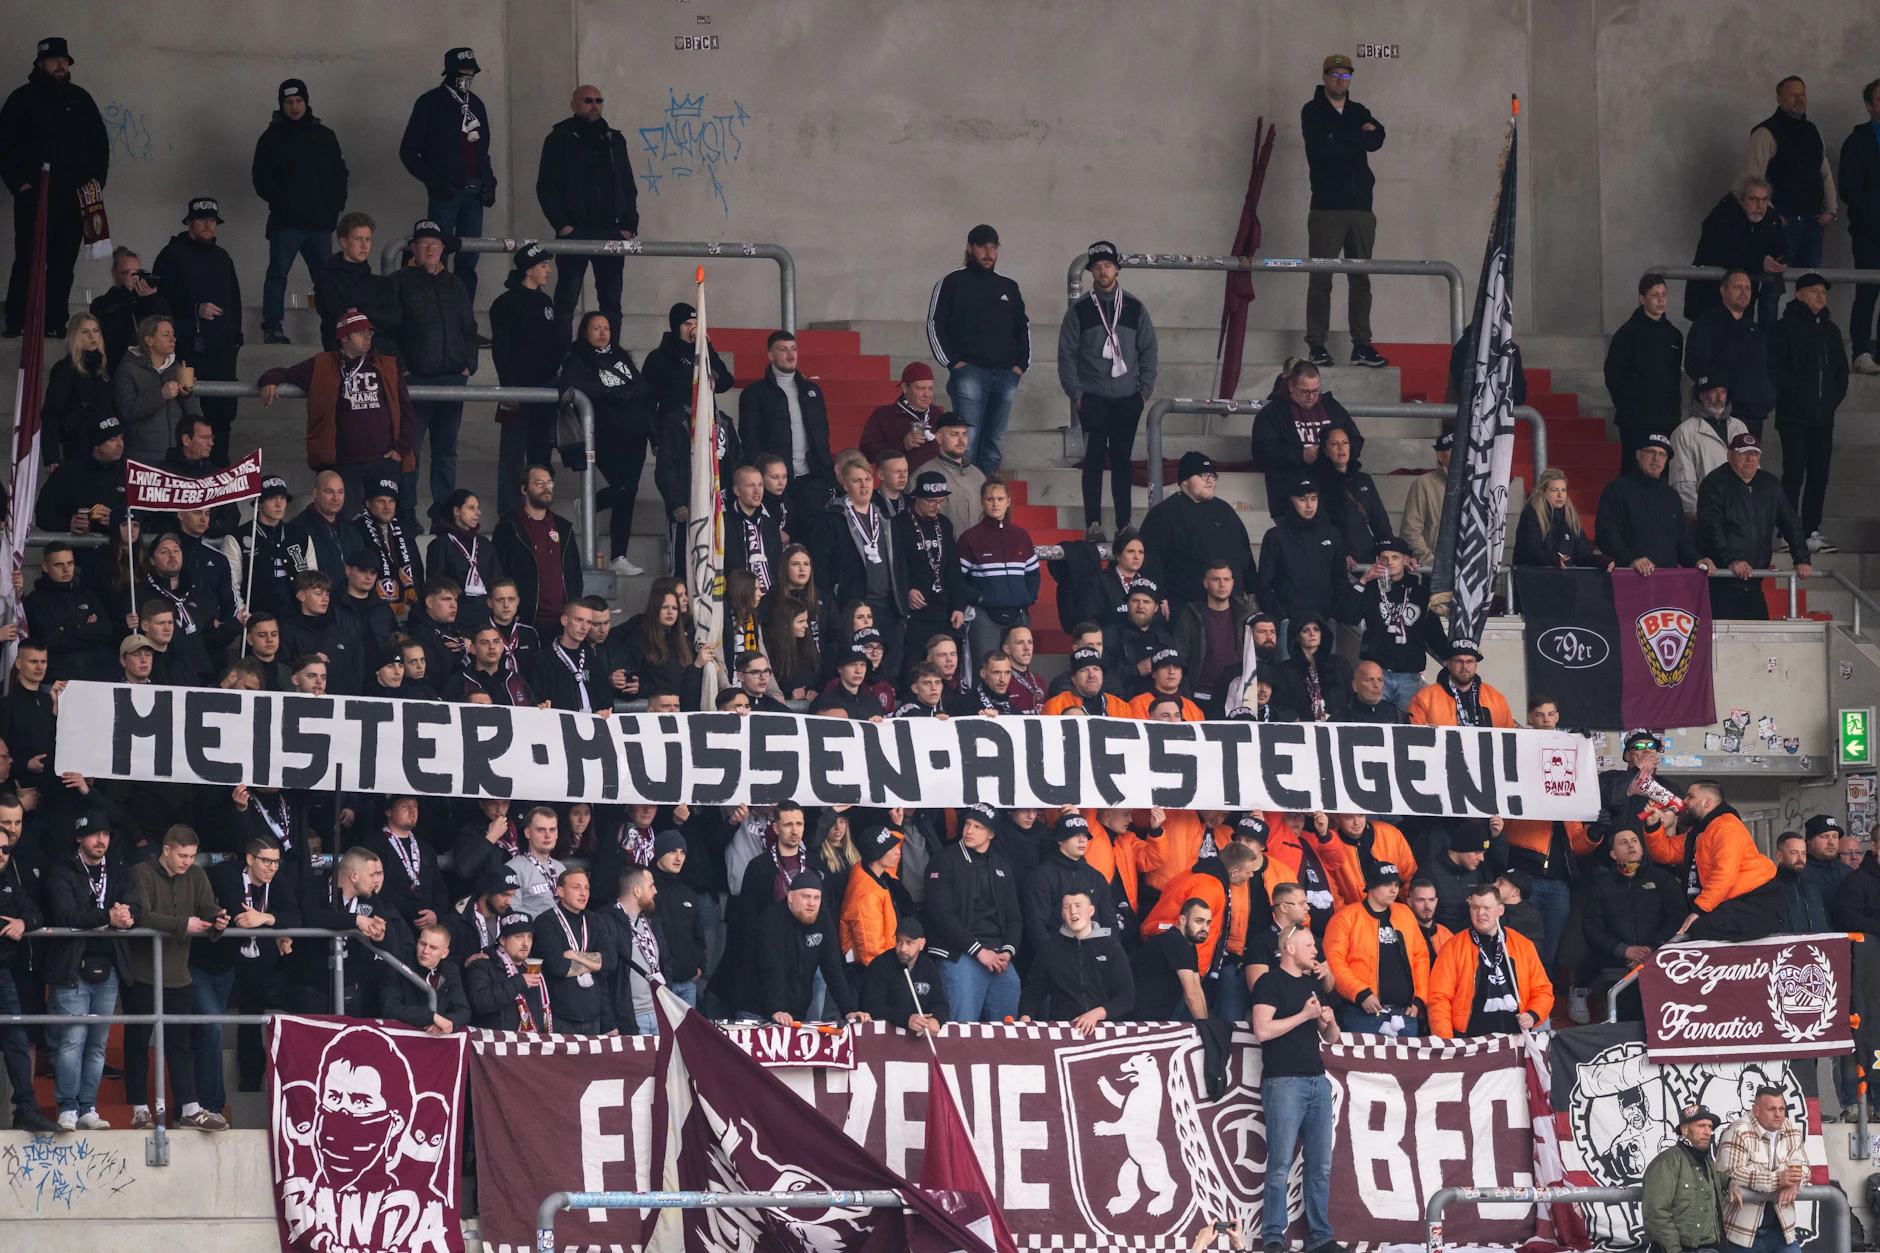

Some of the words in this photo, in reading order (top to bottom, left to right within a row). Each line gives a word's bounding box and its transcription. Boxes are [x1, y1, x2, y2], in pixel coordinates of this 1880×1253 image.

[684, 36, 710, 50] BFC
[1366, 44, 1391, 58] BFC
[128, 469, 162, 487] LANG
[199, 476, 219, 489] DIE
[138, 486, 171, 503] LANG
[172, 489, 204, 504] LEBE
[205, 475, 250, 501] DYNAMO!
[1643, 612, 1692, 637] BFC
[1553, 631, 1593, 662] 79er
[112, 687, 513, 798] MEISTER
[559, 713, 921, 805] MÜSSEN
[955, 718, 1523, 816] AUFSTEIGEN!
[1544, 780, 1577, 794] BANDA
[532, 882, 550, 894] ULT
[1657, 1001, 1763, 1041] Fanatico
[195, 1114, 209, 1125] N
[1346, 1066, 1534, 1221] BFC
[281, 1177, 451, 1253] BANDA
